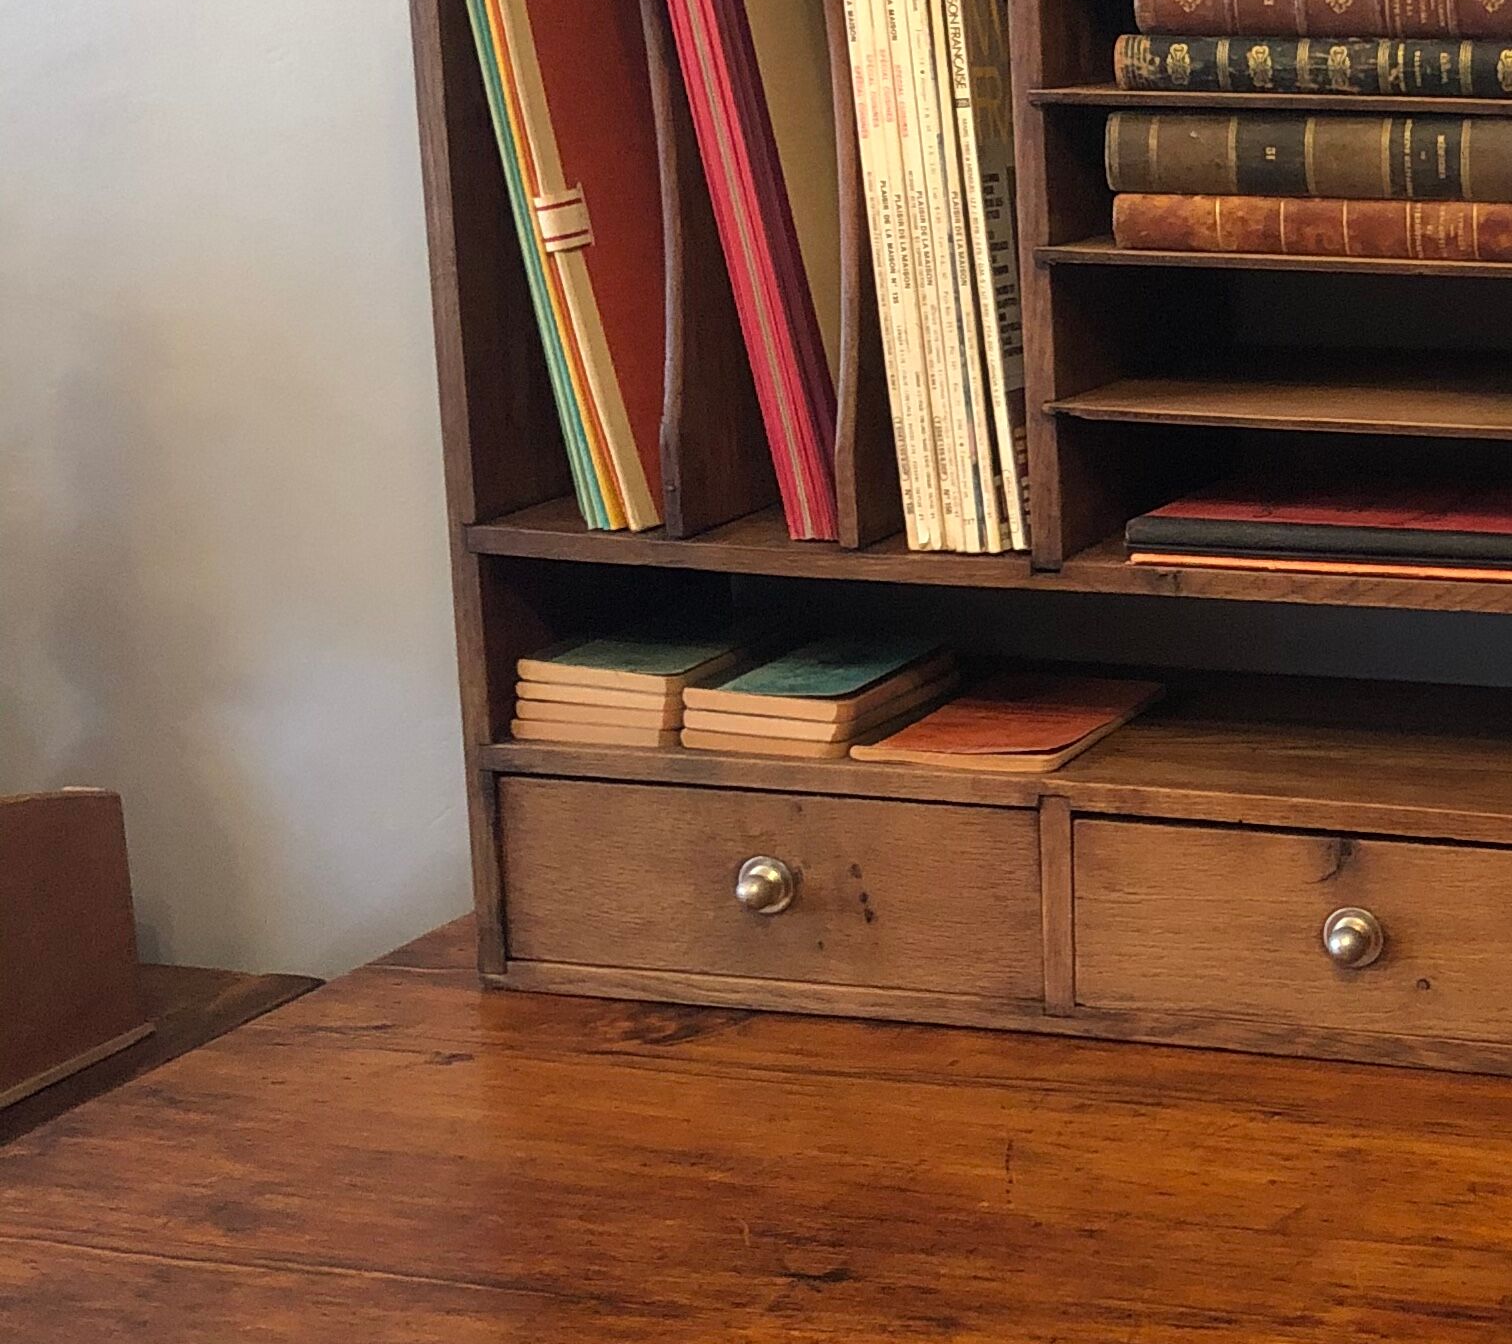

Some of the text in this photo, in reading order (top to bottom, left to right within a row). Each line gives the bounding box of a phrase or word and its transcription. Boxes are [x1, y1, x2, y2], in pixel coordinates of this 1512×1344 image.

[847, 9, 857, 43] MAISON
[888, 8, 898, 41] MAISON
[879, 180, 889, 210] PLAISIR
[883, 214, 891, 225] DE
[885, 228, 892, 238] LA
[894, 193, 911, 289] PLAISIR DE LA MAISON
[916, 190, 933, 285] PLAISIR DE LA MAISON
[951, 190, 967, 286] PLAISIR DE LA MAISON
[886, 242, 896, 274] MAISON
